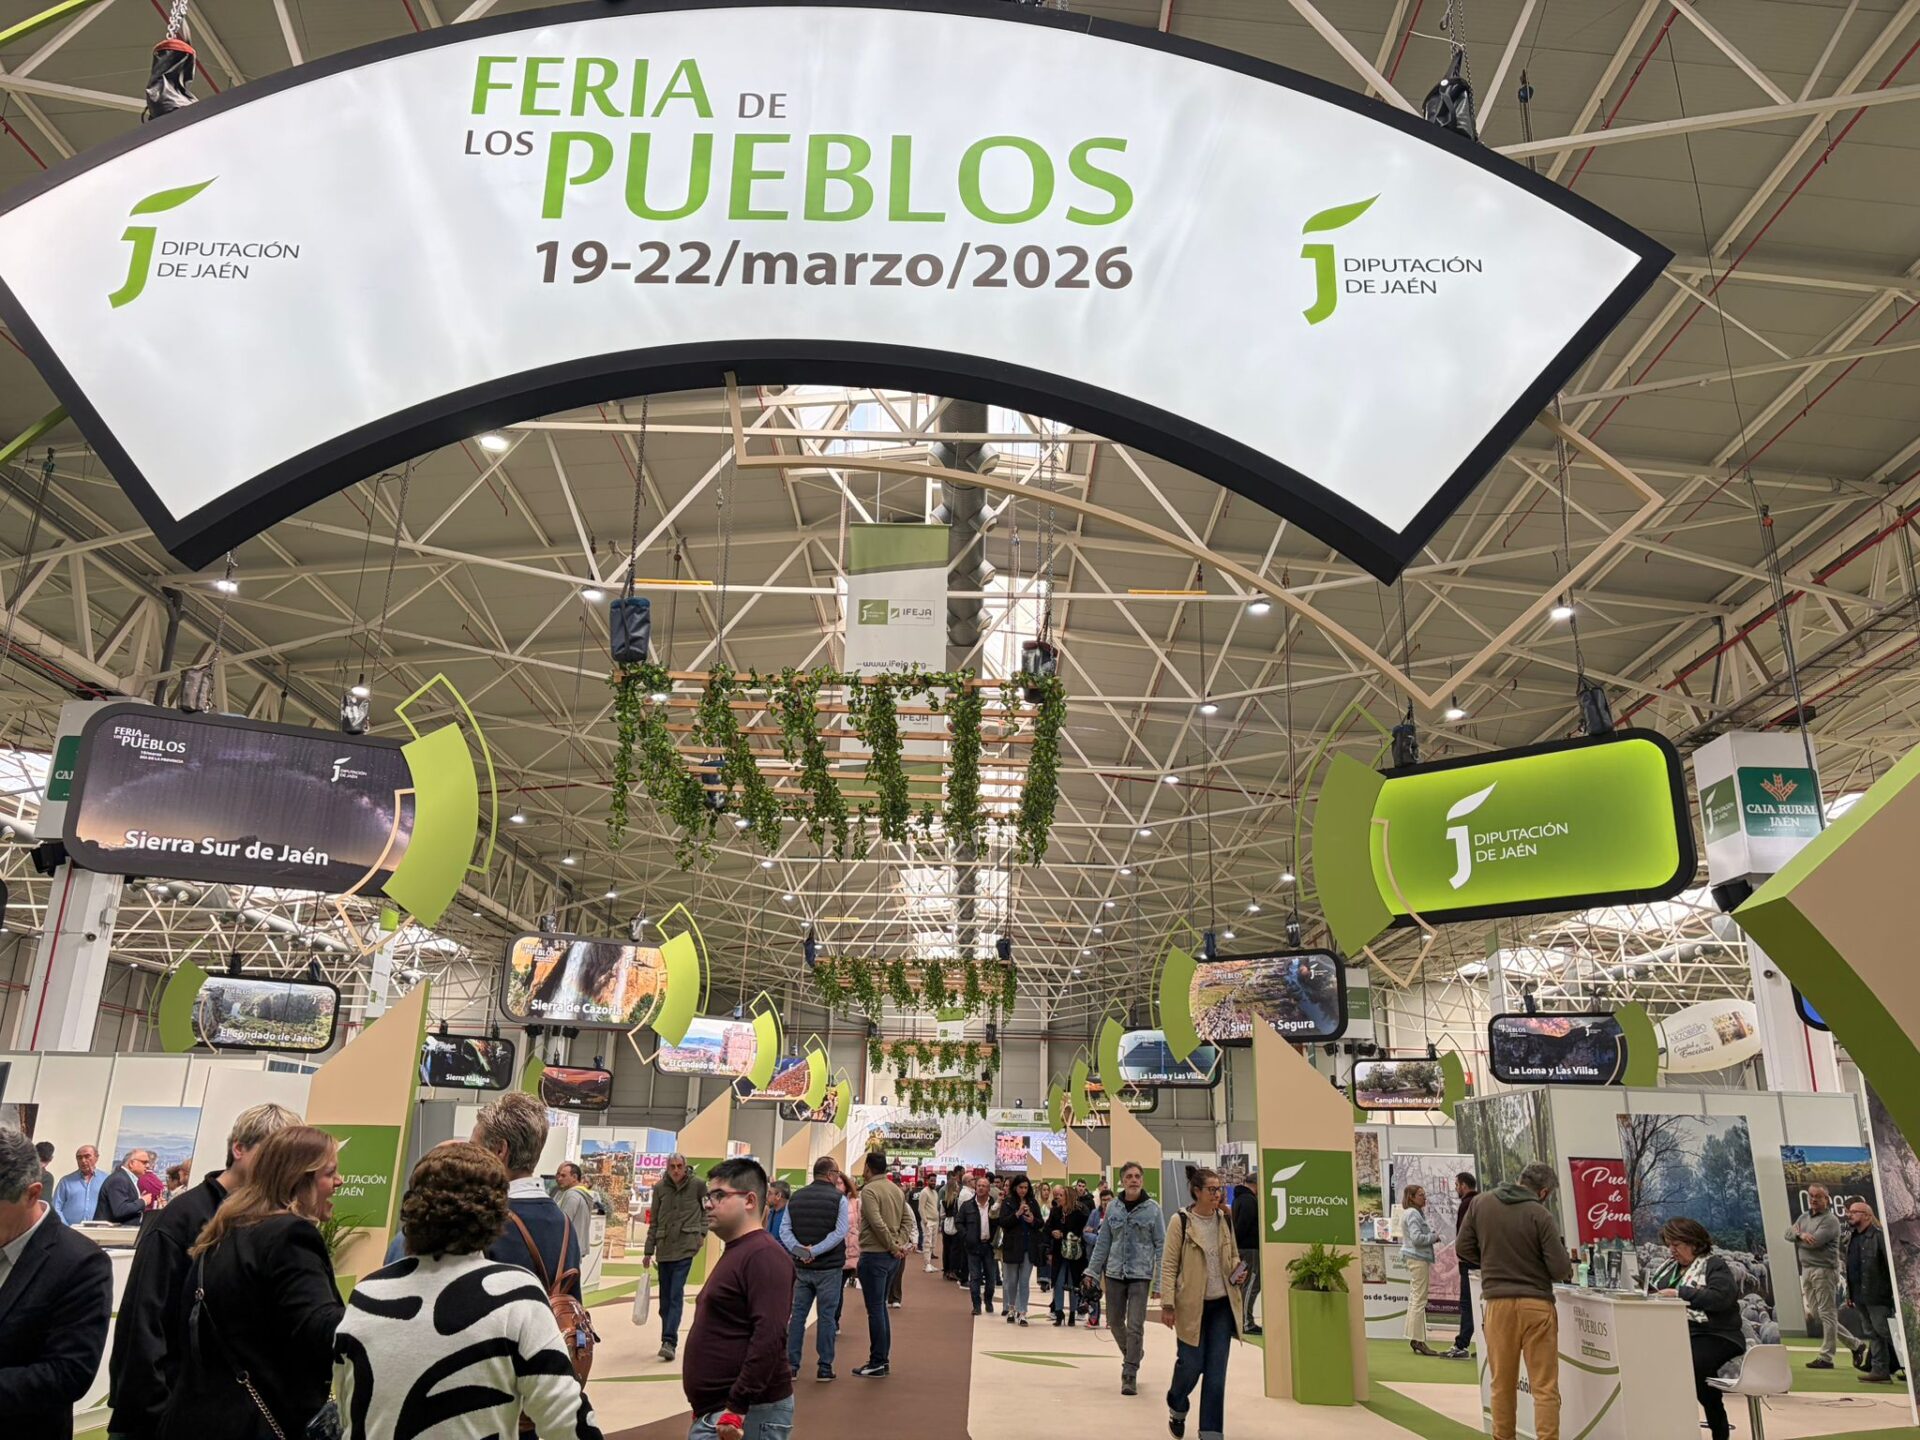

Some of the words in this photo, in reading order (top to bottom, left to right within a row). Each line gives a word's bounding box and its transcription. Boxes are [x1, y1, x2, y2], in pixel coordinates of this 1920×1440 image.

[471, 56, 714, 118] FERIA
[738, 93, 788, 118] DE
[464, 130, 534, 156] LOS
[541, 131, 1134, 226] PUEBLOS
[161, 241, 300, 259] DIPUTACIÓN
[157, 263, 188, 278] DE
[191, 261, 249, 279] JAÉN
[536, 239, 1133, 290] 19-22/marzo/2026
[1343, 256, 1483, 273] DIPUTACIÓN
[1345, 279, 1376, 294] DE
[1380, 277, 1437, 294] JAÉN
[902, 608, 932, 616] IFEJA
[114, 726, 142, 737] FERIA
[121, 736, 186, 753] PUEBLOS
[1746, 803, 1776, 814] CAJA
[1777, 804, 1818, 815] RURAL
[1770, 816, 1800, 828] JAÉN
[1474, 822, 1569, 846] DIPUTACIÓN
[124, 830, 195, 854] Sierra
[201, 837, 244, 857] Sur
[244, 841, 272, 860] de
[277, 845, 329, 866] Jaén
[1475, 849, 1497, 862] DE
[1499, 843, 1537, 860] JAÉN
[531, 1000, 564, 1011] Sierra
[566, 1001, 581, 1012] de
[582, 1003, 623, 1015] Cazorla
[1277, 1020, 1315, 1032] Segura
[231, 1030, 276, 1041] Condado
[277, 1033, 290, 1042] de
[445, 1073, 465, 1081] Sierra
[1509, 1066, 1520, 1075] La
[1521, 1066, 1547, 1075] Loma
[1548, 1068, 1554, 1077] y
[1555, 1066, 1571, 1075] Las
[1572, 1066, 1599, 1075] Villas
[901, 1131, 935, 1139] CLIMÁTICO
[339, 1186, 364, 1197] JAÉN
[1608, 1189, 1624, 1203] de
[1289, 1195, 1348, 1206] DIPUTACIÓN
[1289, 1207, 1303, 1216] DE
[1304, 1206, 1329, 1216] JAÉN
[1383, 1294, 1409, 1303] Segura
[1578, 1318, 1608, 1337] PUEBLOS
